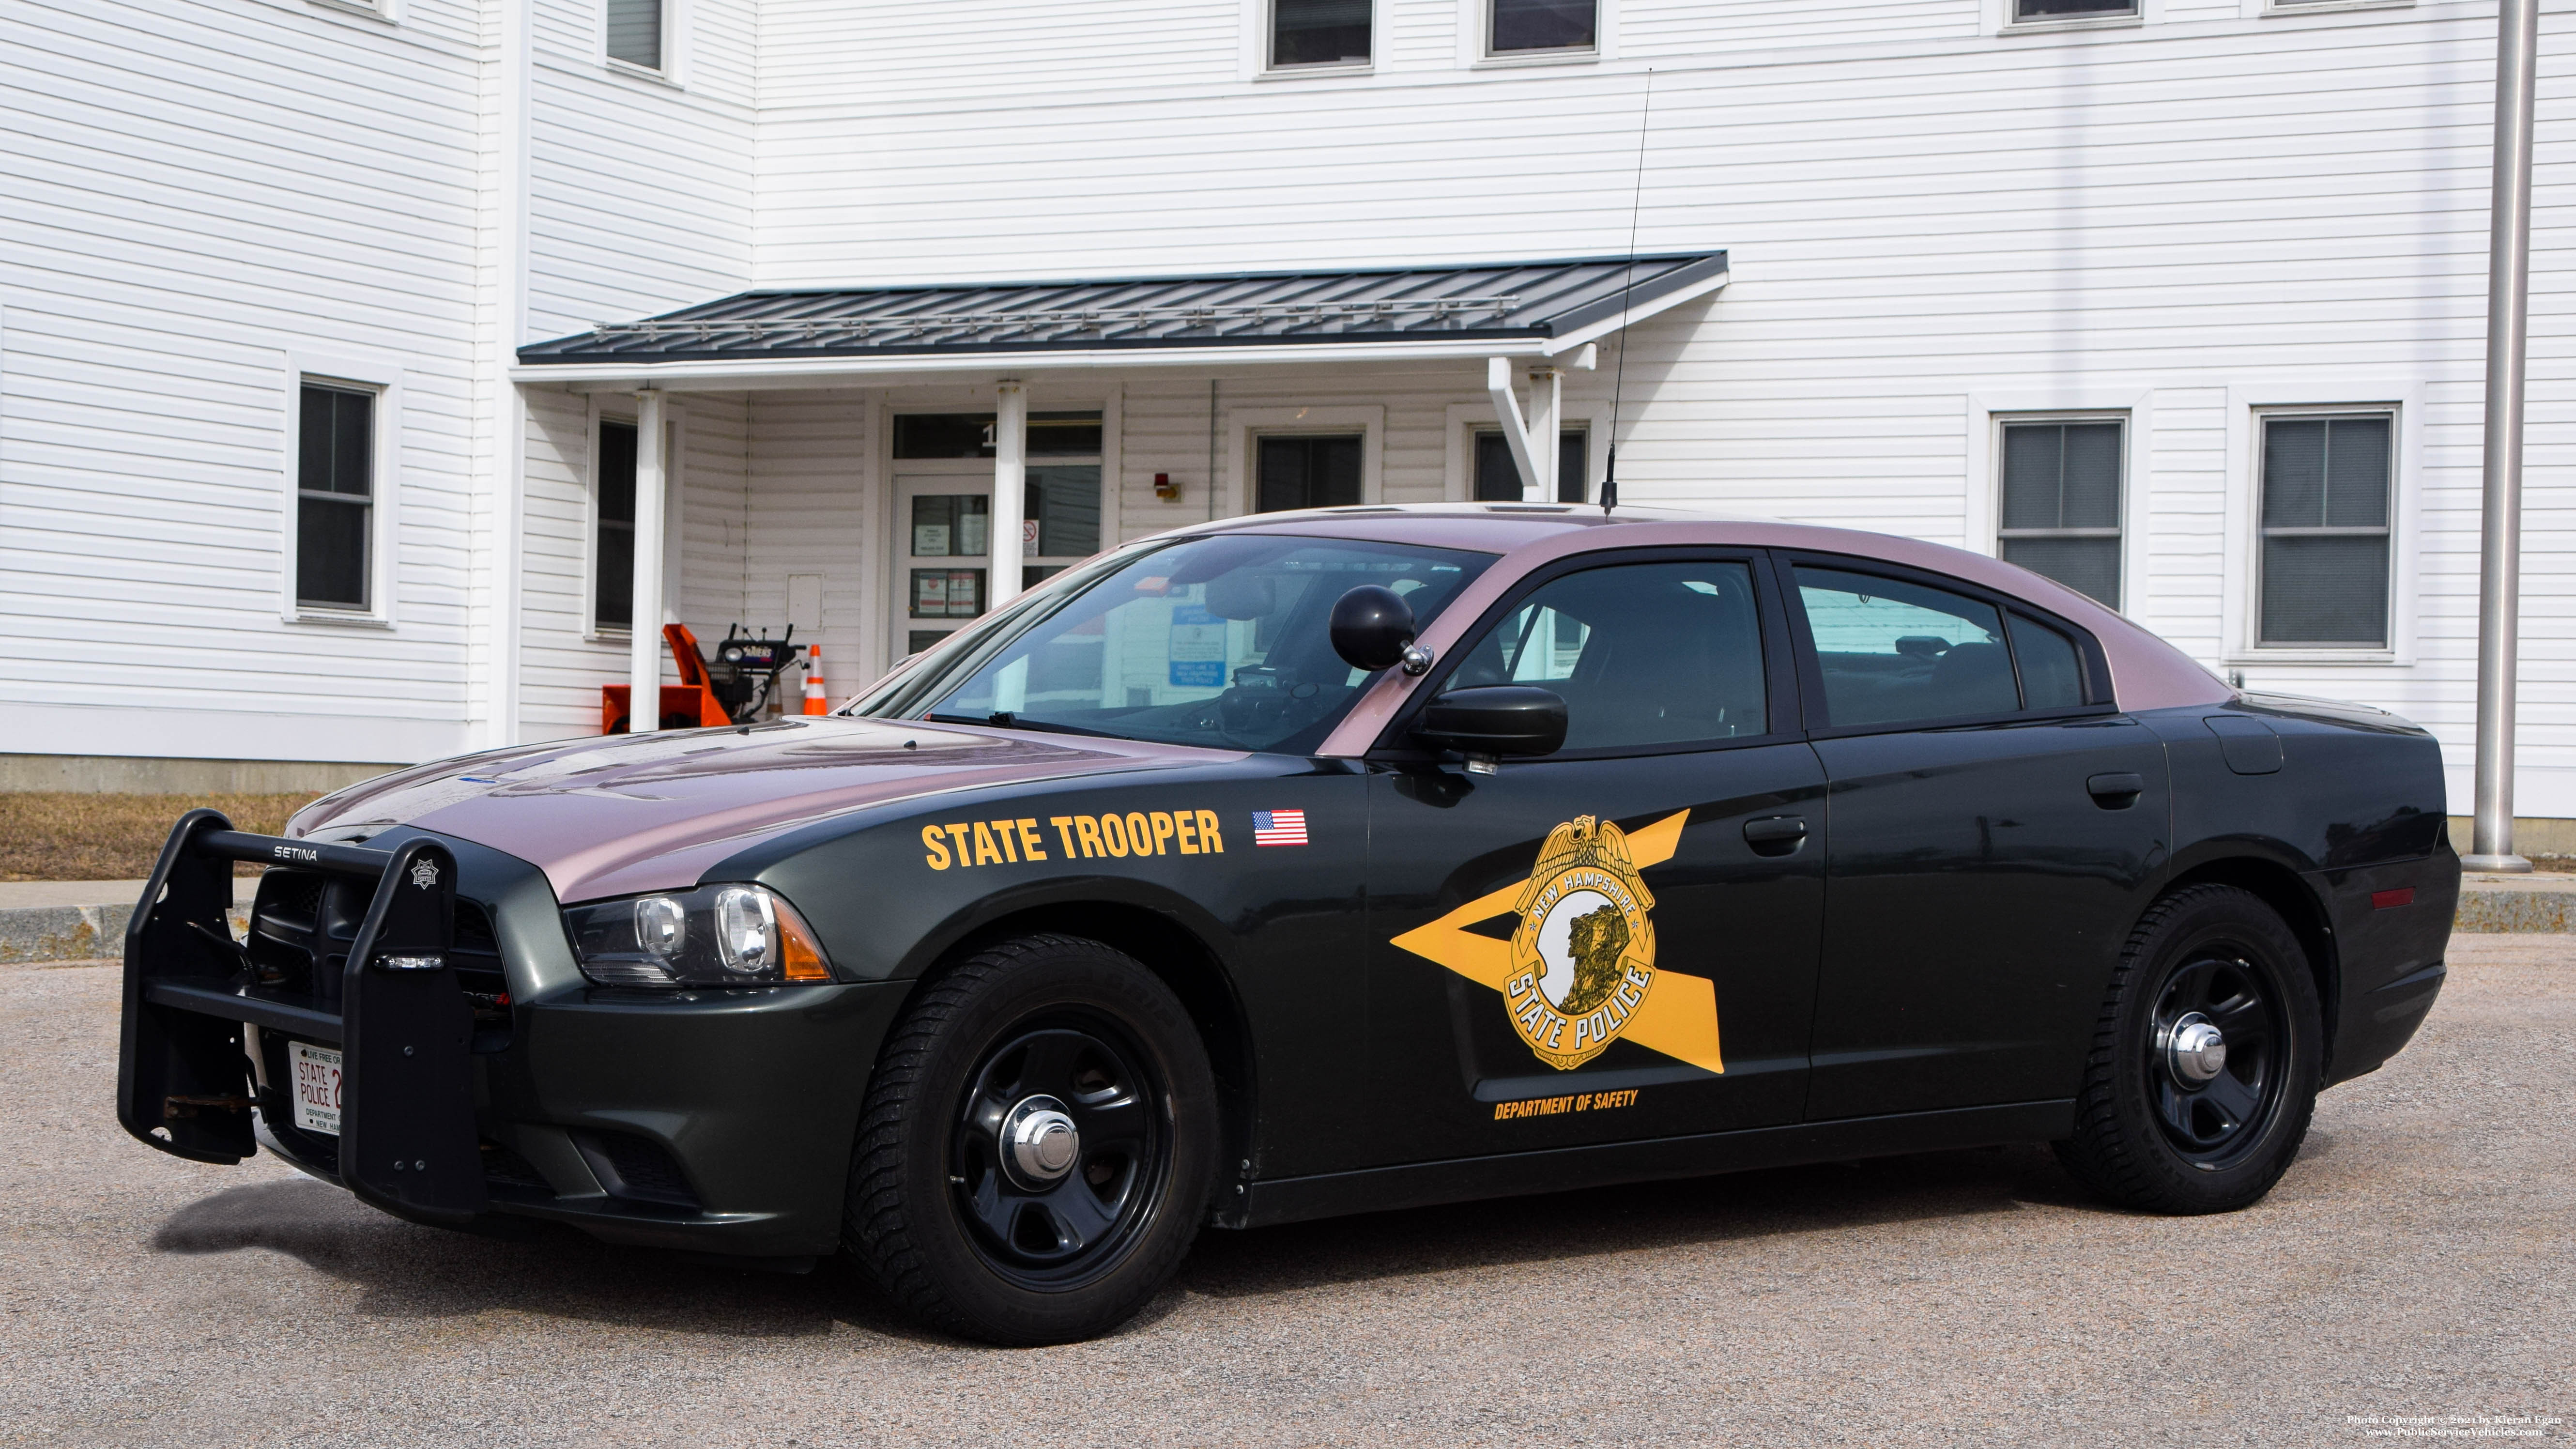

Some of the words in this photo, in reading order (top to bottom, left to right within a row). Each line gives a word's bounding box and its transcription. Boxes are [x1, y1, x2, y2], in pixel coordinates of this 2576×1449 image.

[922, 818, 1047, 870] STATE
[1050, 810, 1224, 859] TROOPER
[275, 846, 317, 861] SETINA
[1533, 884, 1560, 919] NEW
[1564, 872, 1636, 917] HAMPSHIRE
[1509, 972, 1567, 1048] STATE
[1575, 966, 1651, 1049] POLICE
[307, 1050, 318, 1060] LIVE
[319, 1053, 332, 1064] FREE
[333, 1056, 341, 1065] OR
[299, 1062, 327, 1085] STATE
[301, 1083, 330, 1107] POLICE
[1494, 1096, 1574, 1120] DEPARTMENT
[1576, 1094, 1593, 1111] OF
[1593, 1090, 1639, 1110] SAFETY
[306, 1108, 336, 1121] DEPARTMENT
[316, 1120, 327, 1128] NEW
